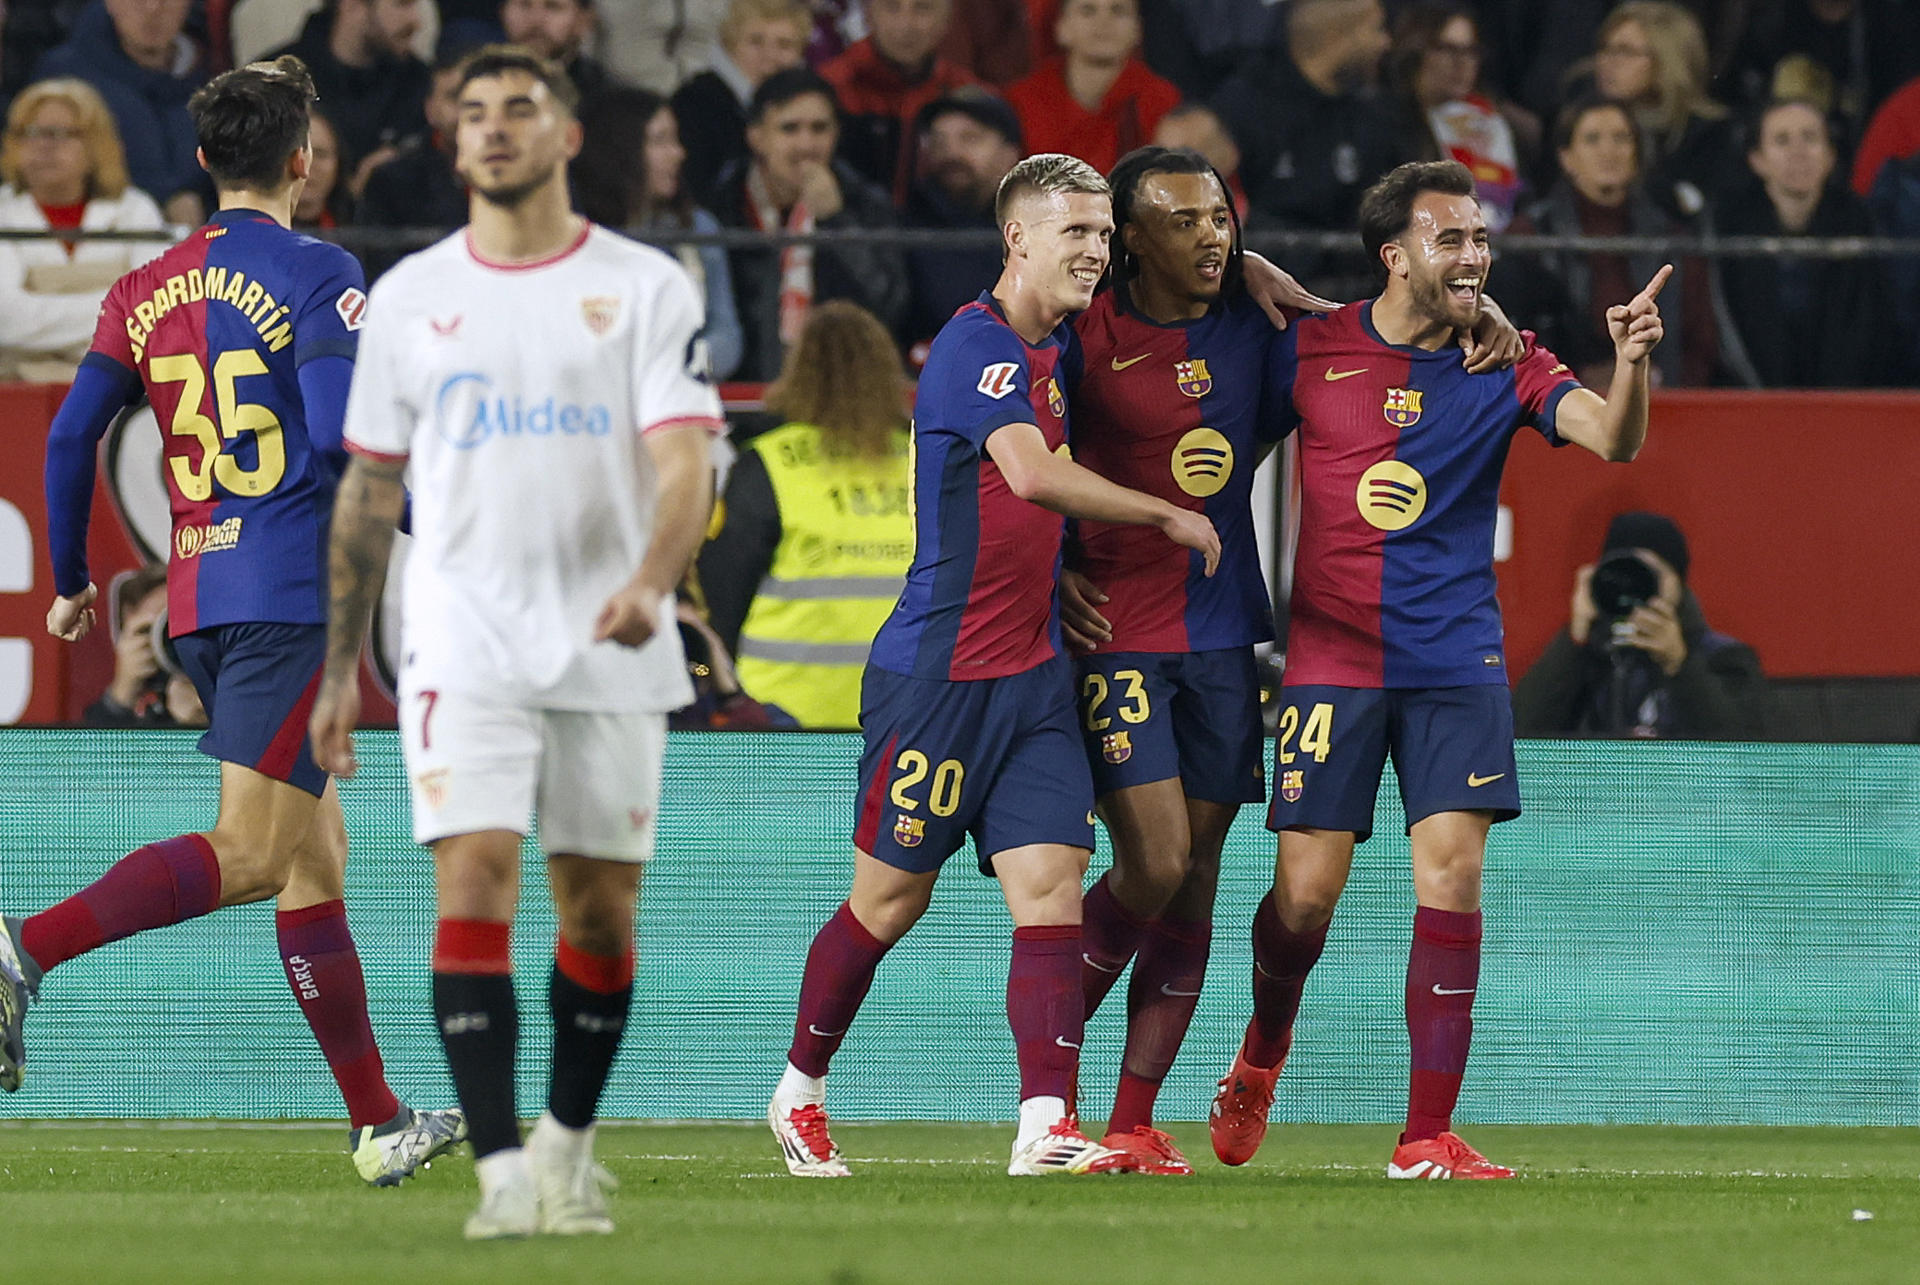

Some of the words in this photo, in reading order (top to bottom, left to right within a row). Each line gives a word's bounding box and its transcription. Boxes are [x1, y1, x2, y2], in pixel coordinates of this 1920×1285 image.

[149, 348, 286, 501] 35
[438, 382, 612, 448] Midea
[416, 690, 439, 751] 7
[1084, 669, 1151, 732] 23
[1279, 702, 1335, 765] 24
[890, 749, 965, 817] 20
[289, 955, 320, 1000] BARÇA
